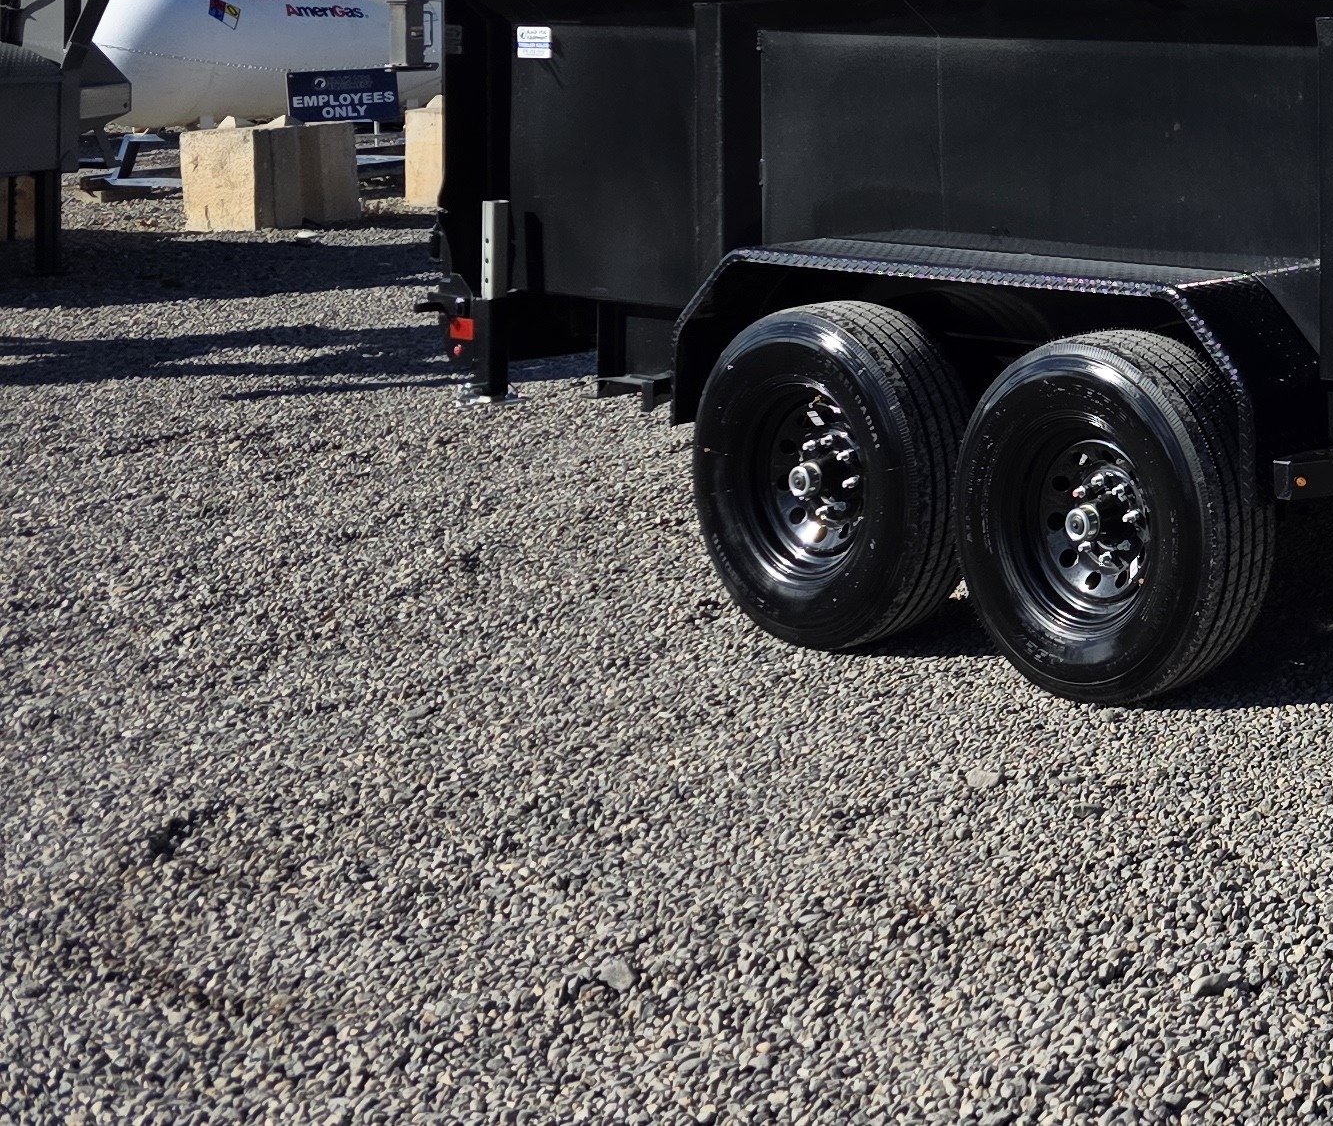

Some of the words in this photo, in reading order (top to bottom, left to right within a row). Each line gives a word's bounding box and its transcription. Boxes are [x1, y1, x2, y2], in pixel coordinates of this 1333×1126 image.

[286, 3, 364, 19] AmeriGas
[292, 90, 395, 108] EMPLOYEES
[322, 105, 367, 119] ONLY
